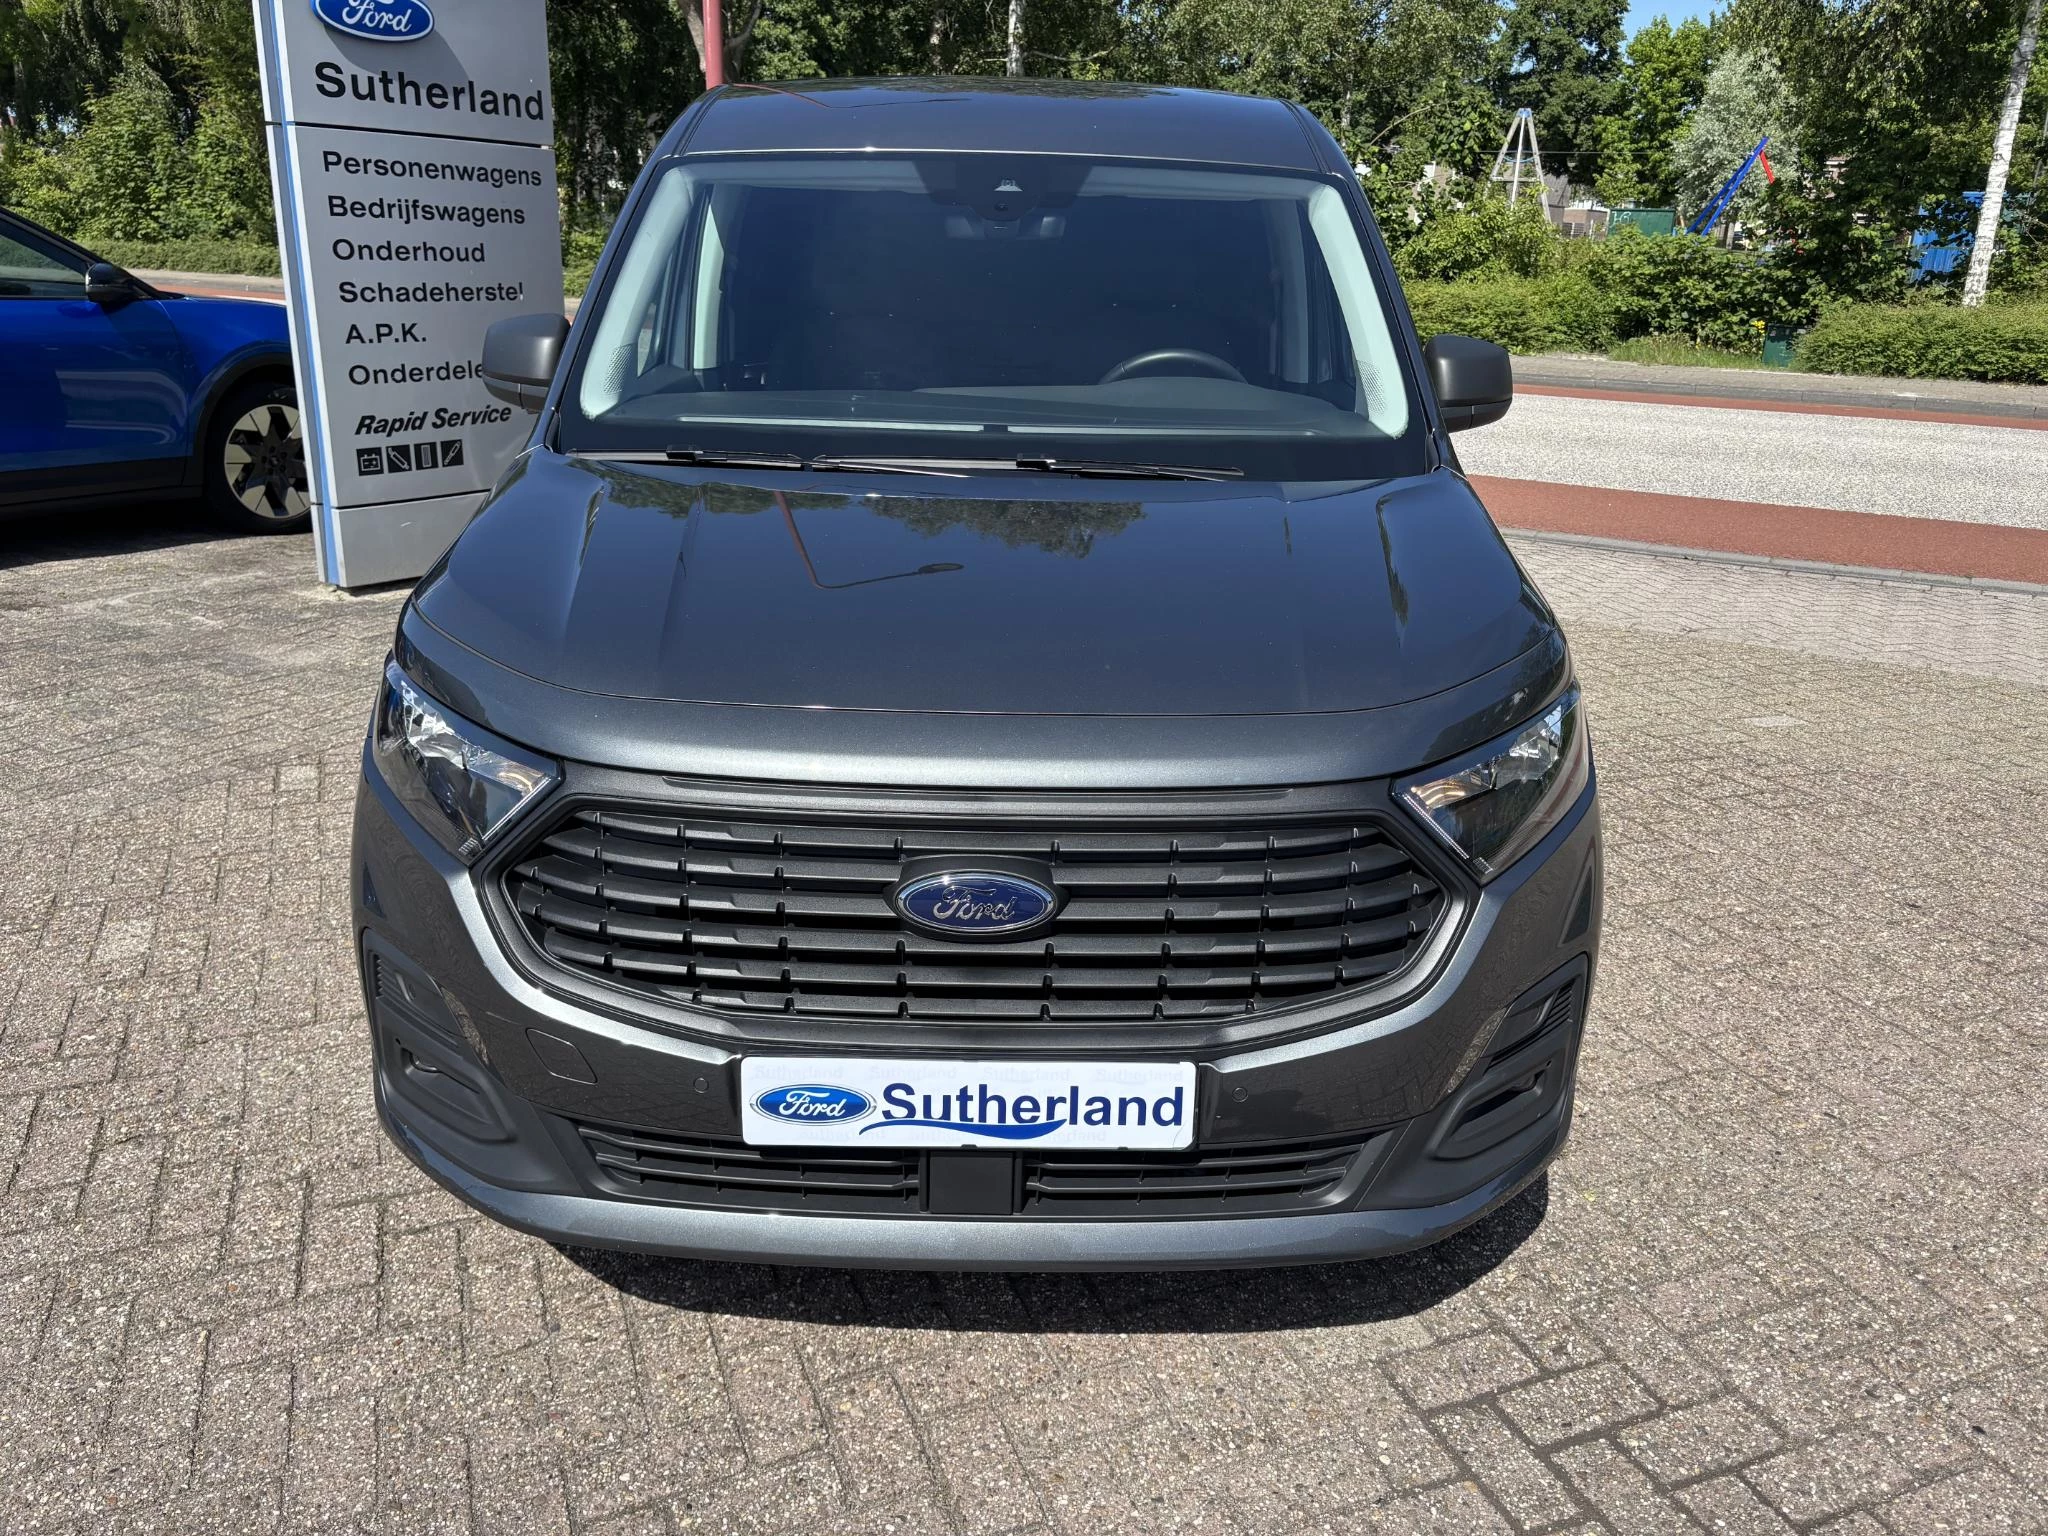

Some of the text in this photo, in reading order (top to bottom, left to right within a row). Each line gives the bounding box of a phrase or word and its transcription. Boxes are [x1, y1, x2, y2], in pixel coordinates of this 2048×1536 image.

[341, 0, 412, 32] Ford
[314, 61, 545, 121] Sutherland
[322, 150, 542, 188] Personenwagens
[327, 194, 526, 227] Bedrijfswagens
[332, 238, 486, 263] Onderhoud
[345, 322, 427, 345] A.P.K.
[348, 359, 483, 386] Onderdele
[354, 404, 512, 438] Rapid Service
[932, 885, 1018, 921] Ford
[779, 1082, 1184, 1127] Ford Sutherland
